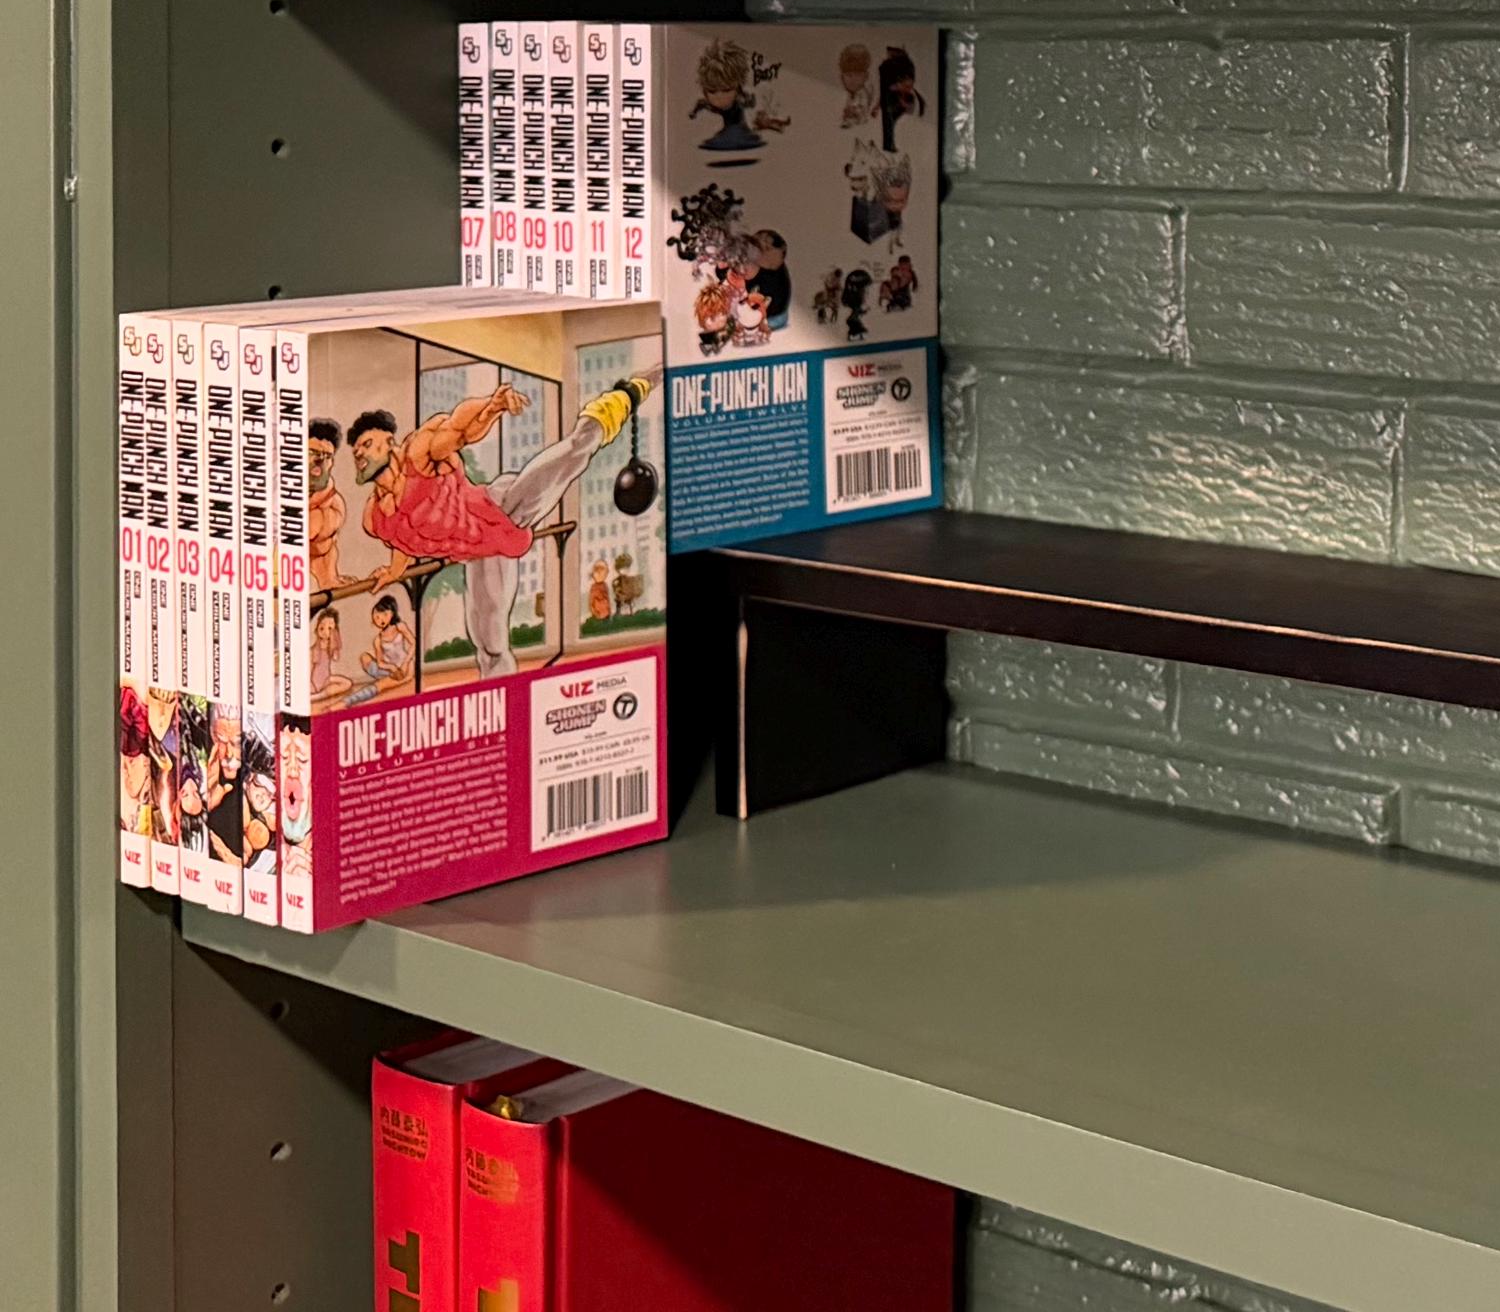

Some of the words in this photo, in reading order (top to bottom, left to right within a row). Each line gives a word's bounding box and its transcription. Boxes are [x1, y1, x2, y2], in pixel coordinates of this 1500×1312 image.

[460, 76, 484, 170] ONE-PUNCH
[492, 69, 516, 164] ONE-PUNCH
[522, 74, 545, 170] ONE-PUNCH
[550, 76, 575, 174] ONE-PUNCH
[586, 74, 610, 172] ONE-PUNCH
[622, 79, 645, 178] ONE-PUNCH
[461, 175, 484, 210] MAN
[494, 169, 516, 203] MAN
[524, 175, 546, 210] MAN
[552, 178, 575, 213] MAN
[587, 177, 610, 212] MAN
[622, 182, 645, 219] MAN
[461, 217, 484, 249] 07
[493, 210, 517, 242] 08
[523, 217, 547, 249] 09
[553, 220, 574, 253] 10
[591, 219, 605, 253] 11
[625, 226, 642, 259] 12
[672, 366, 770, 419] ONE-PUNCH
[773, 361, 807, 405] MAN
[848, 364, 875, 378] VIZ
[121, 370, 144, 477] ONE-PUNCH
[145, 377, 168, 486] ONE-PUNCH
[176, 378, 198, 489] ONE-PUNCH
[672, 413, 736, 428] VOLUME
[208, 385, 232, 496] ONE-PUNCH
[242, 389, 267, 501] ONE-PUNCH
[280, 388, 303, 501] ONE-PUNCH
[122, 480, 145, 521] MAN
[147, 489, 168, 530] MAN
[177, 492, 199, 532] MAN
[209, 499, 232, 540] MAN
[244, 504, 267, 546] MAN
[281, 504, 304, 546] MAN
[122, 526, 142, 564] 01
[147, 535, 170, 573] 02
[177, 539, 199, 576] 03
[209, 547, 234, 585] 04
[244, 553, 268, 592] 05
[280, 553, 304, 593] 06
[560, 680, 594, 698] VIZ
[338, 696, 460, 768] ONE-PUNCH
[463, 686, 507, 740] MAN
[546, 699, 607, 724] SHONEN
[553, 713, 597, 734] JUMP
[339, 748, 441, 779] VOLUME
[467, 734, 507, 750] SIX
[124, 848, 142, 866] VIZ
[155, 859, 173, 877] VIZ
[183, 866, 201, 883] VIZ
[214, 878, 233, 896] VIZ
[249, 888, 268, 906] VIZ
[286, 891, 304, 909] VIZ
